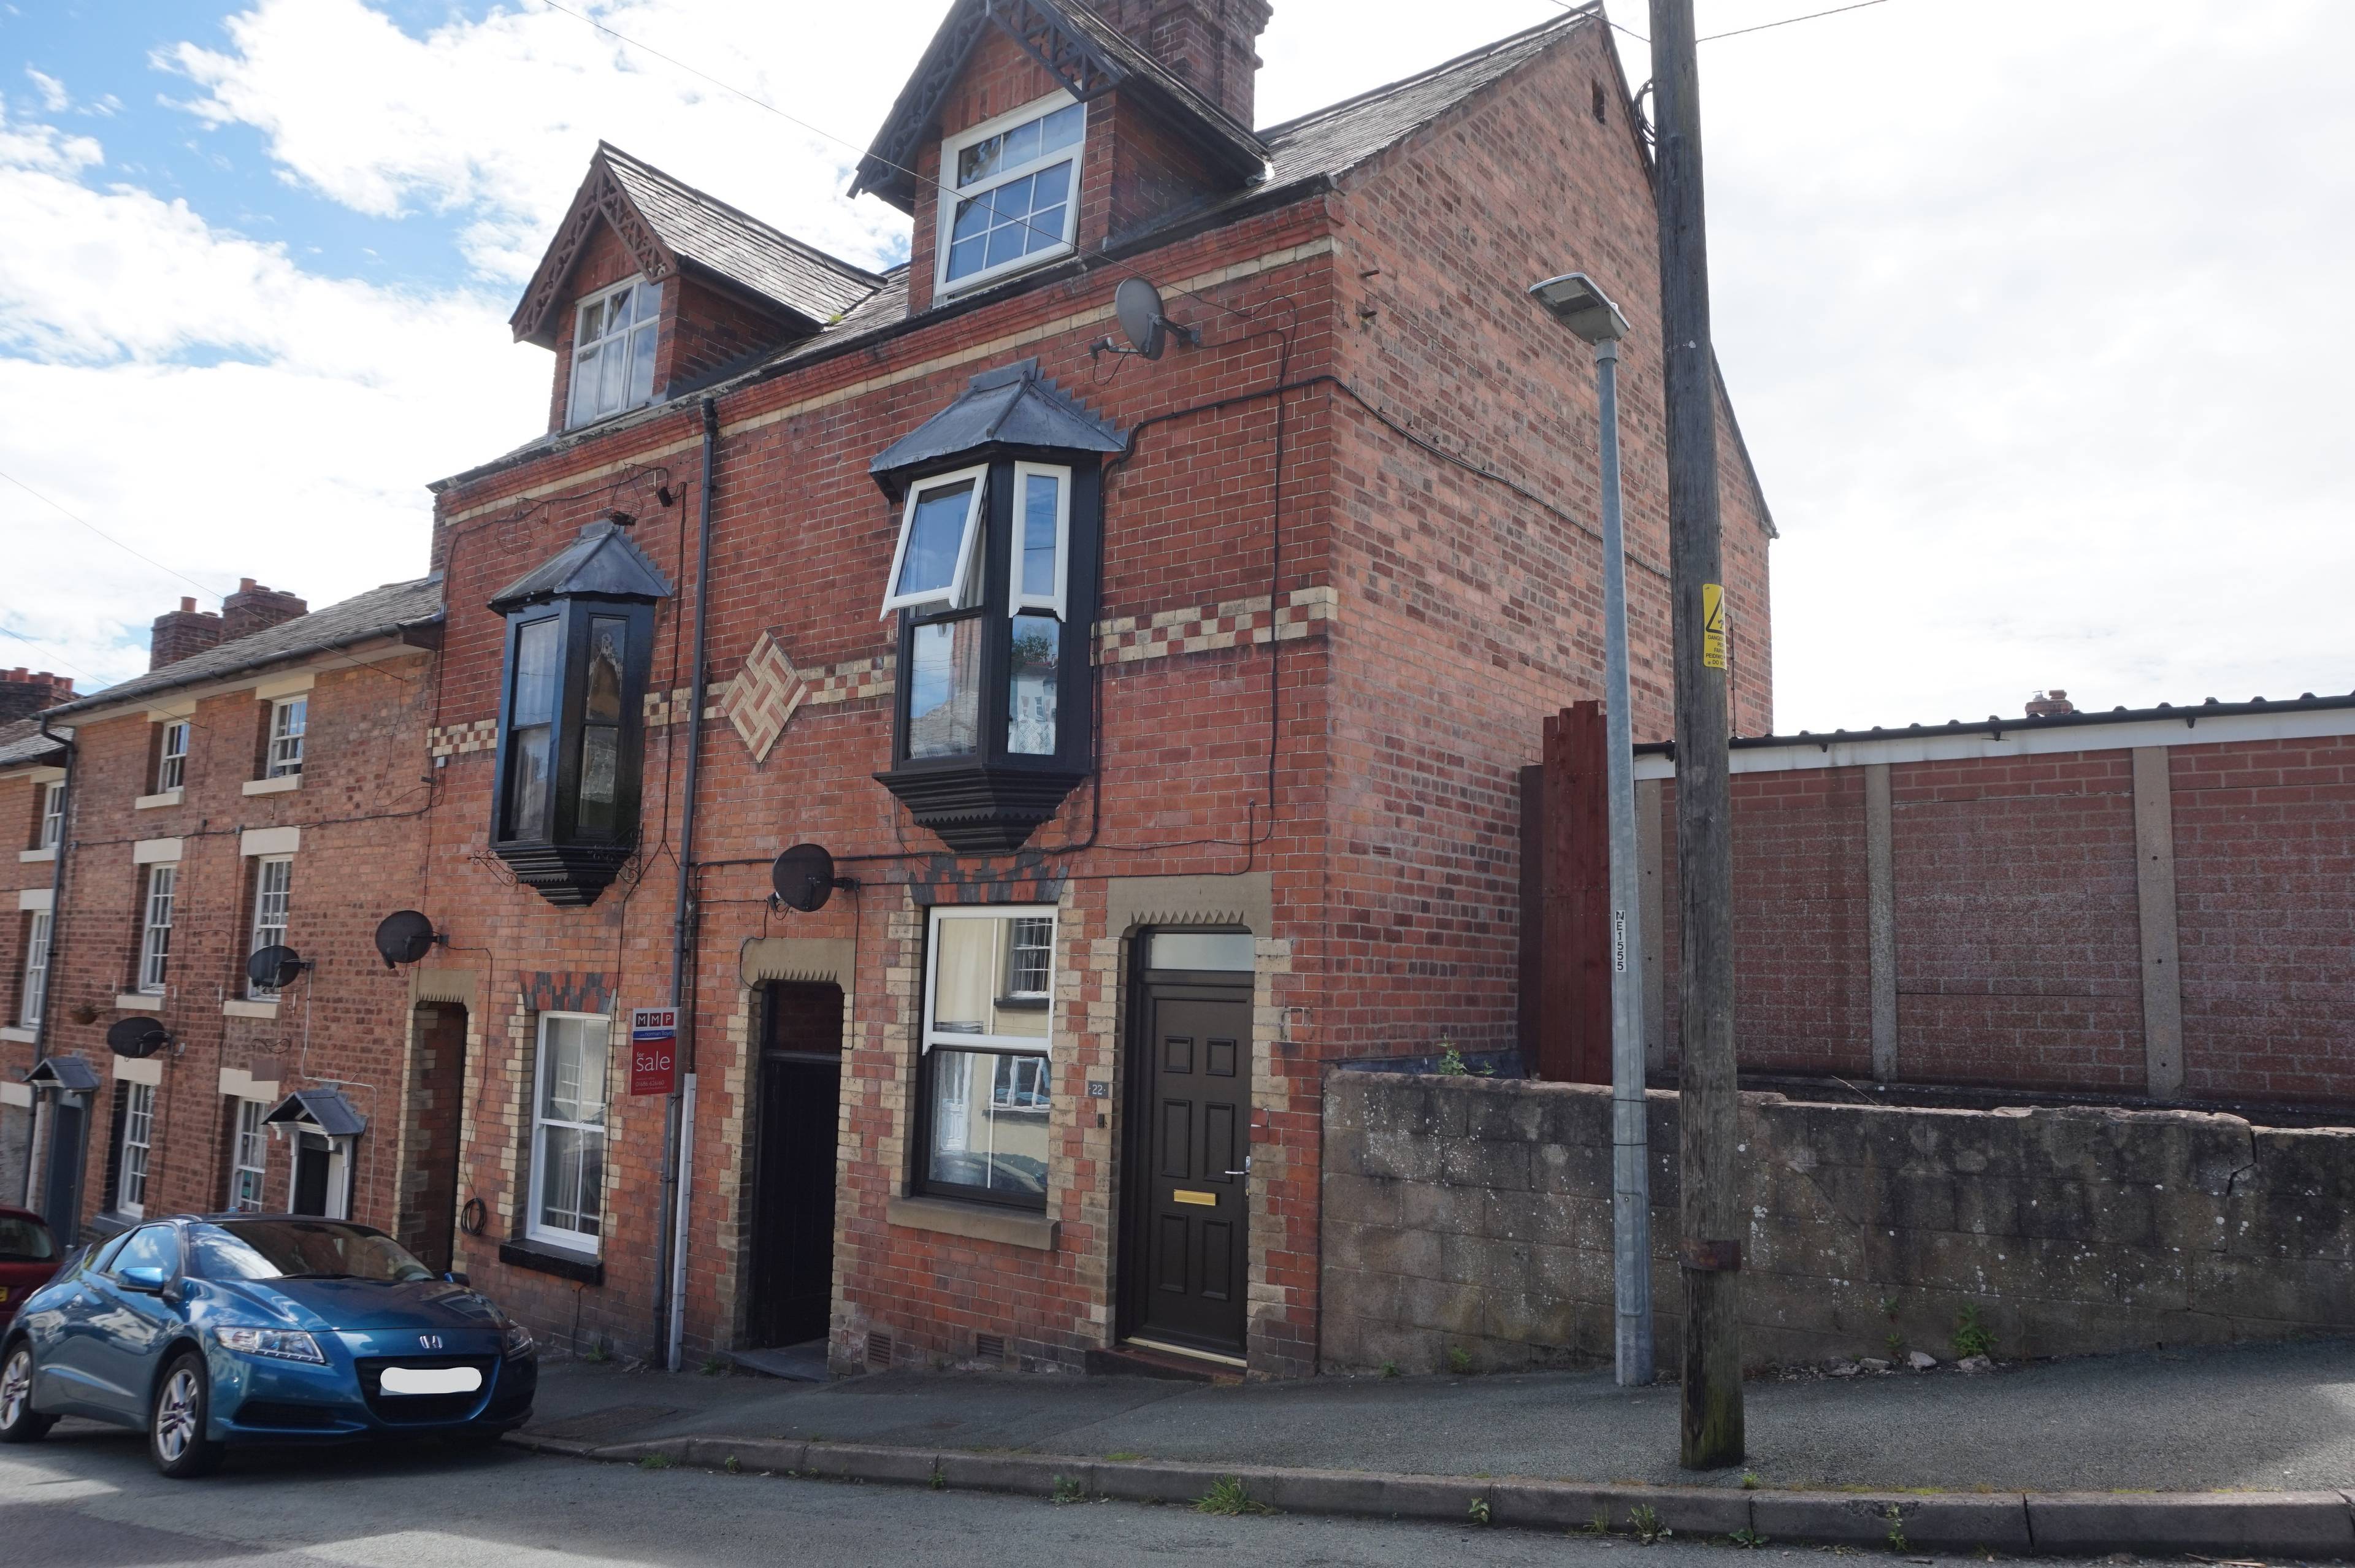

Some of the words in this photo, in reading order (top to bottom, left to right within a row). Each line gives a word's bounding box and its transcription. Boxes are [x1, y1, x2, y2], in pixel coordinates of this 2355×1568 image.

[1616, 911, 1625, 971] NE1555
[636, 1050, 670, 1072] sale
[1092, 1084, 1103, 1095] 22
